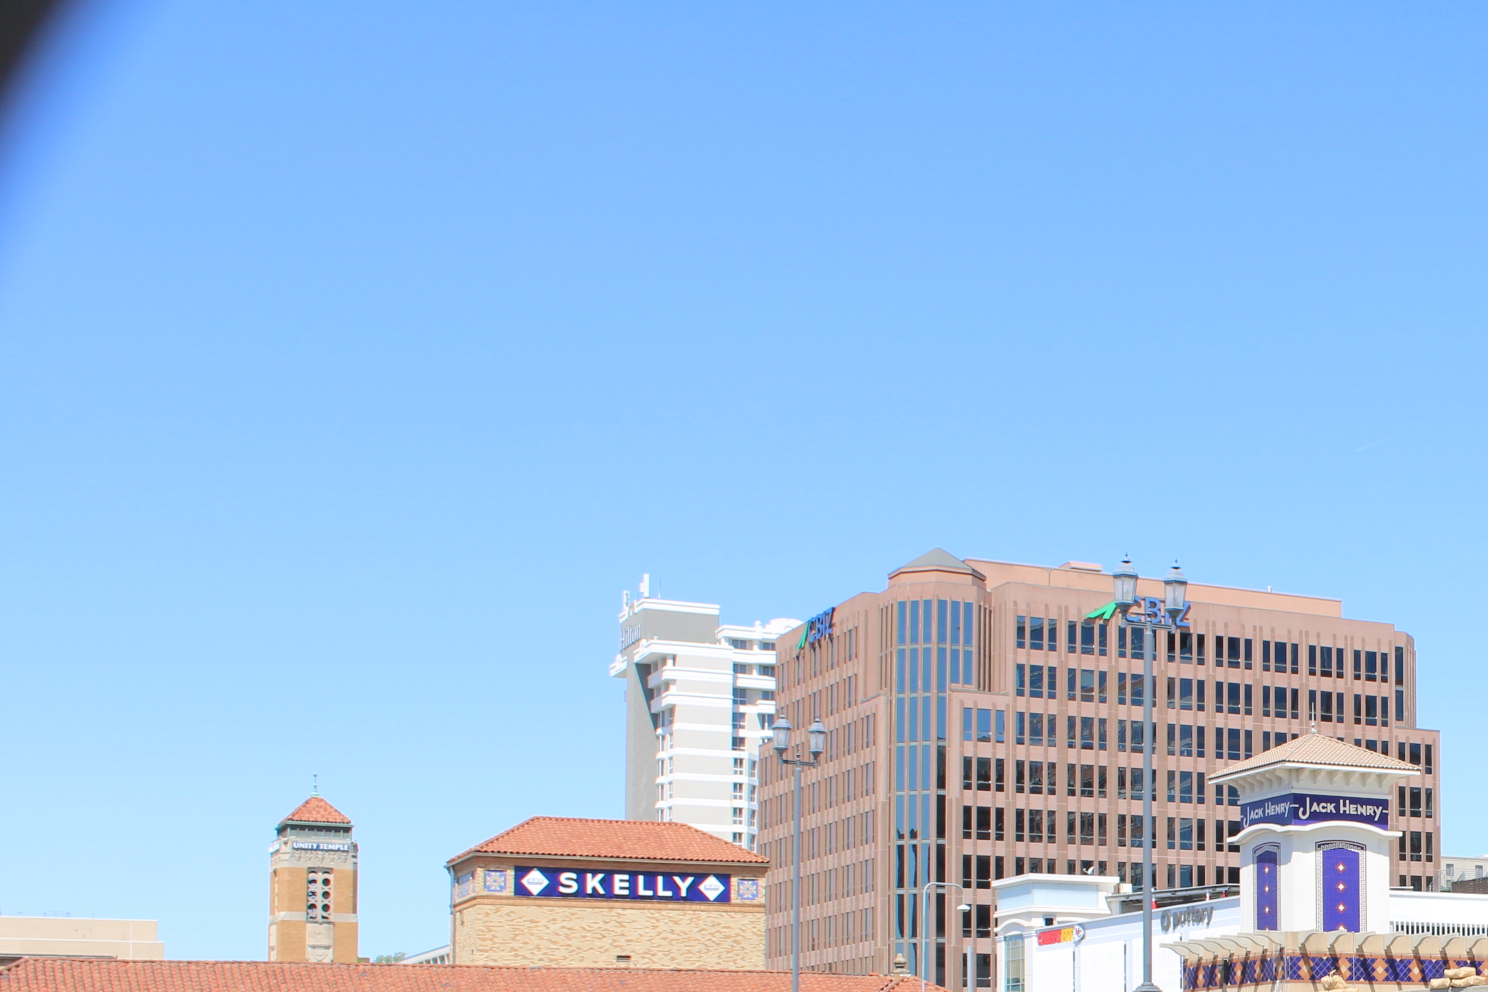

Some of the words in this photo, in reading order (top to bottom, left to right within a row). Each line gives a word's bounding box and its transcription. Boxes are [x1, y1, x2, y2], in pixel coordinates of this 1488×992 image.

[620, 624, 641, 650] Hilton
[808, 606, 835, 643] CBIZ
[557, 871, 695, 898] SKELLY
[1173, 906, 1213, 931] puttery
